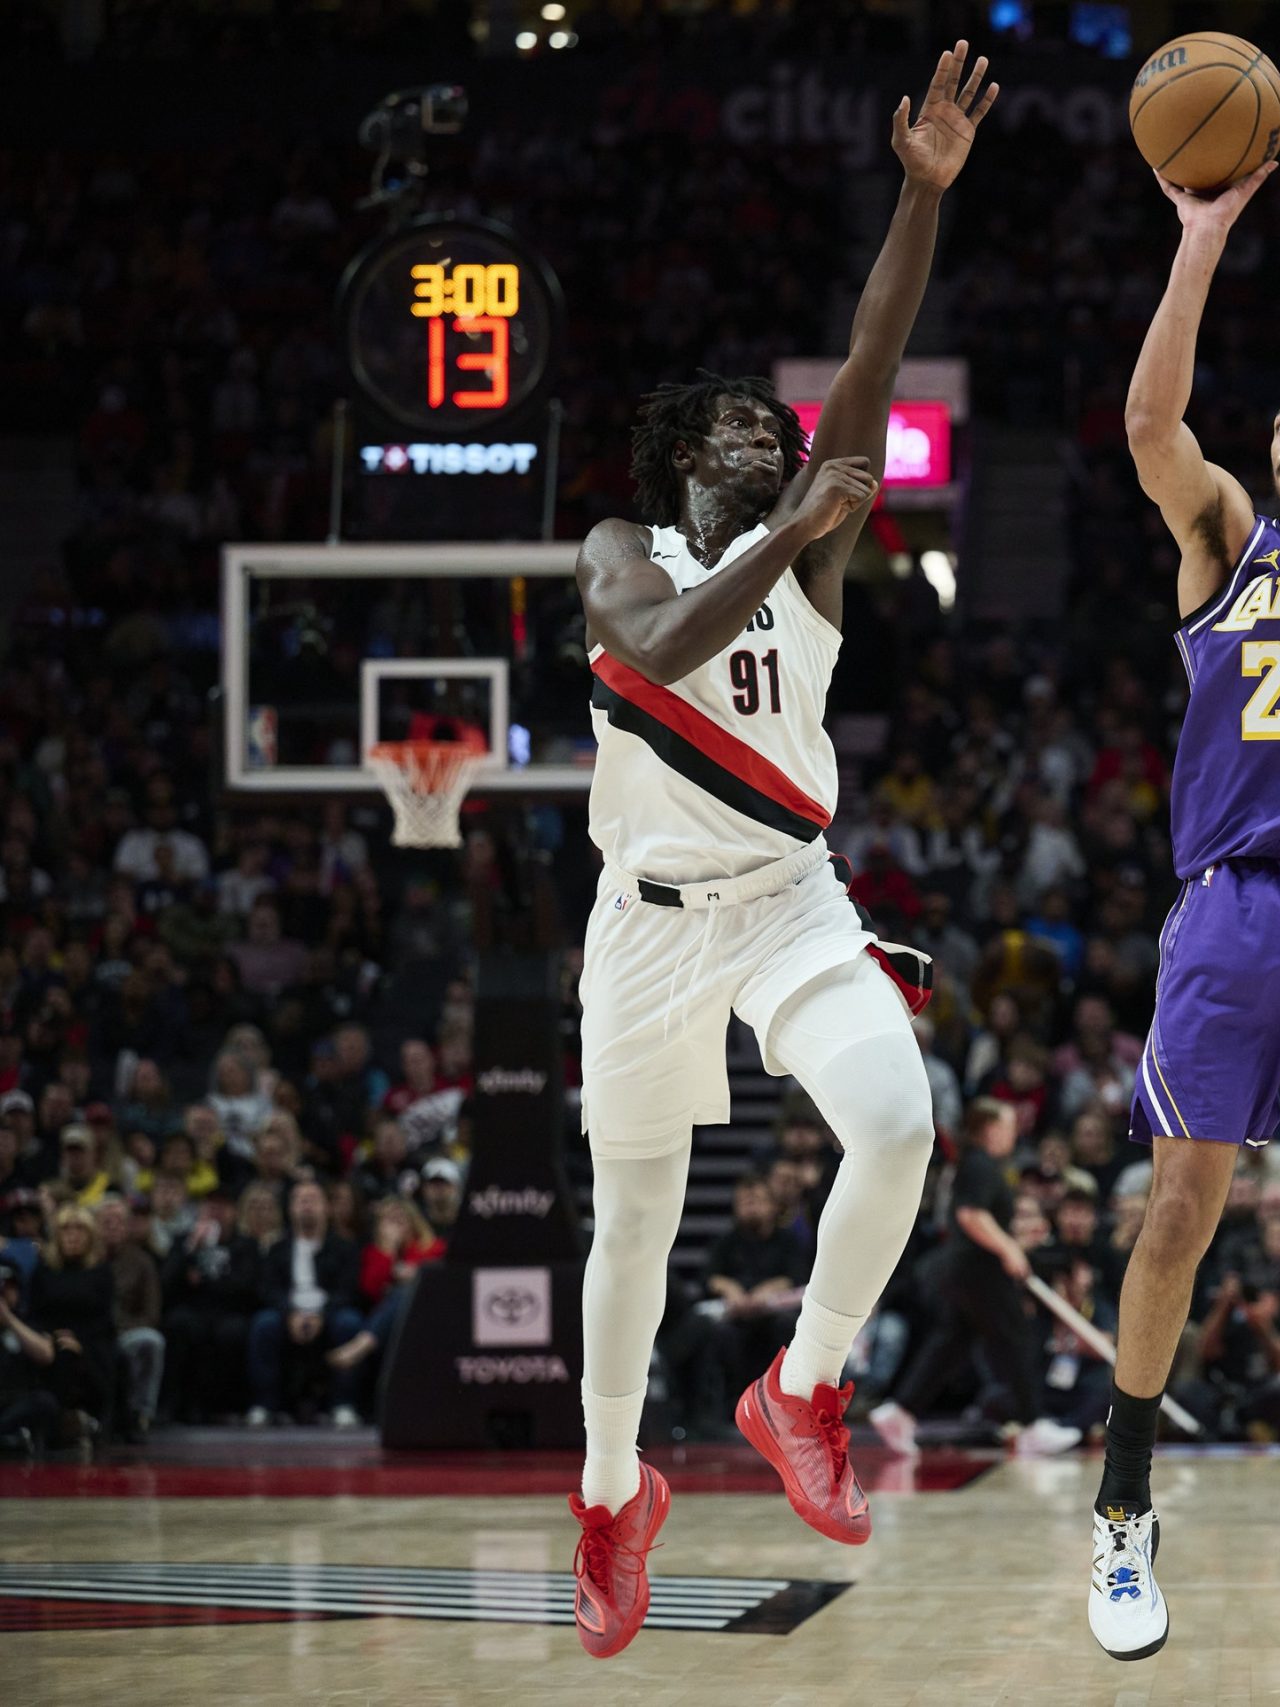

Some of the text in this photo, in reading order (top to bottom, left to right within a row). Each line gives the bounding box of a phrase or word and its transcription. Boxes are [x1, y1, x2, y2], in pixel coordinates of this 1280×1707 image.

[410, 264, 519, 317] 3:00
[428, 317, 509, 409] 13
[407, 443, 537, 474] TISSOT
[729, 649, 782, 716] 91
[478, 1066, 548, 1096] xfinity
[469, 1184, 556, 1218] xfinity
[455, 1356, 570, 1384] TOYOTA
